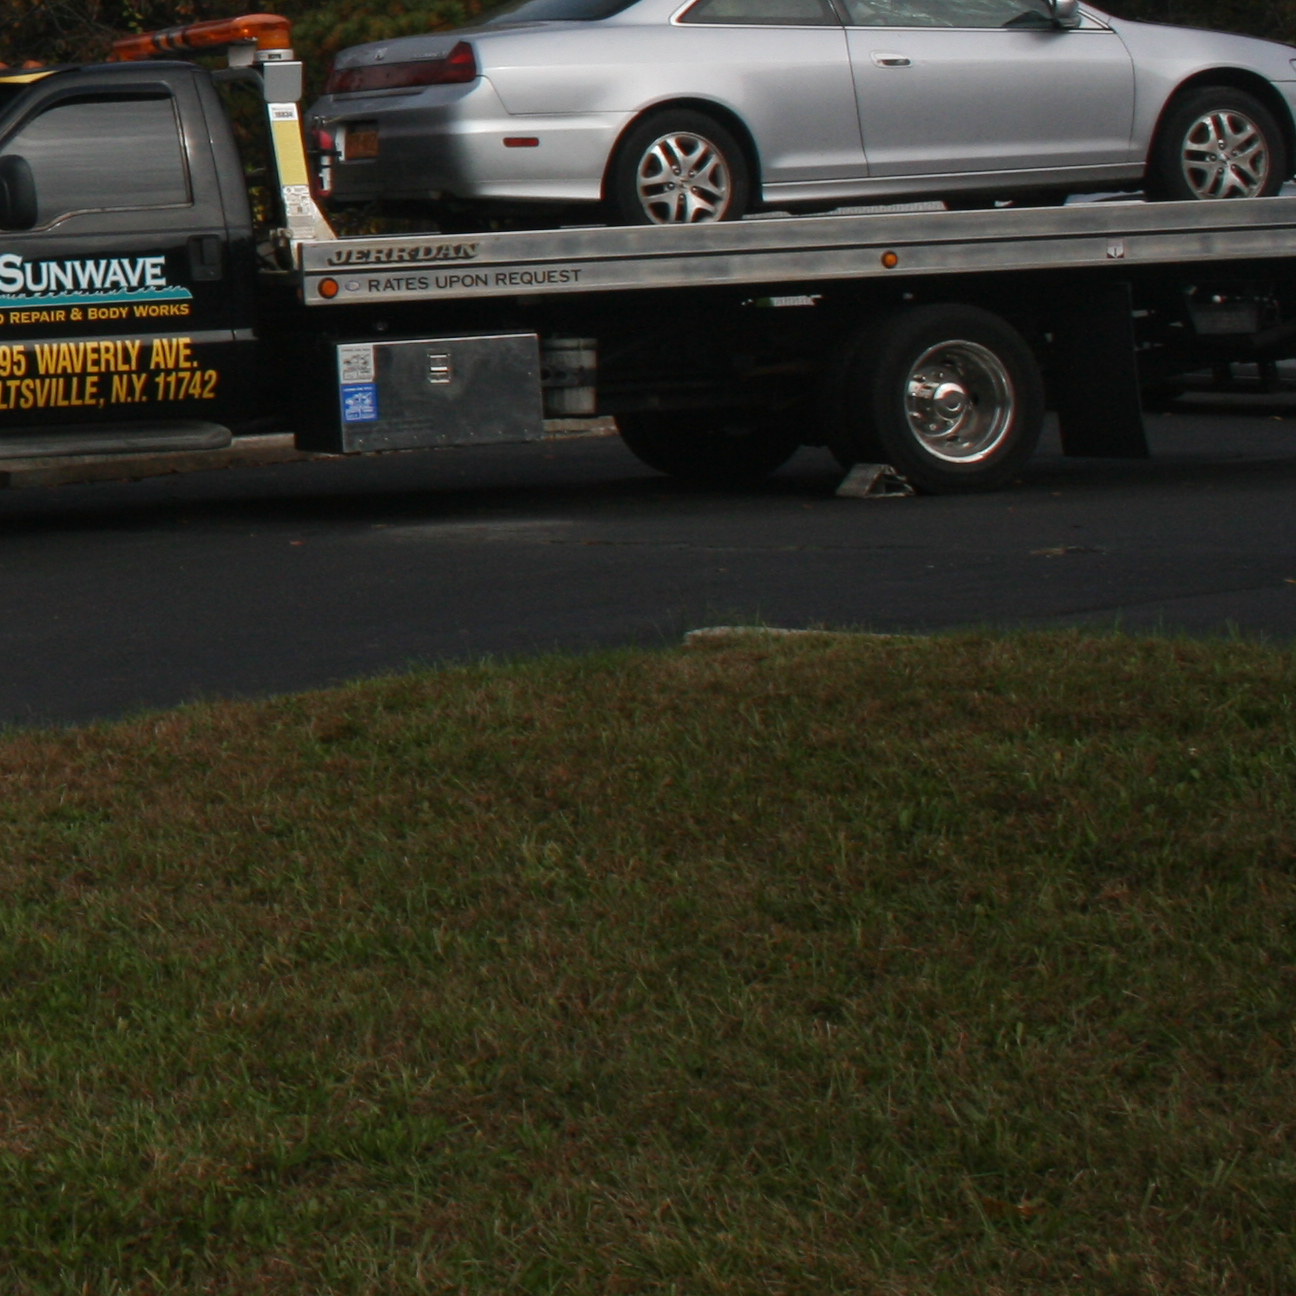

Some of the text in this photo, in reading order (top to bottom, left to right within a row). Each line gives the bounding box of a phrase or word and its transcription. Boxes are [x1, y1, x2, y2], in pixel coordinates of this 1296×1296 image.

[368, 269, 582, 292] RATES UPON REQUEST
[9, 310, 66, 324] REPAIR
[70, 308, 82, 321] &
[87, 306, 128, 320] BODY
[133, 304, 189, 317] WORKS
[35, 340, 141, 375] WAVERLY
[150, 337, 198, 370] AVE.
[111, 373, 147, 403] N.Y.
[155, 370, 218, 401] 11742
